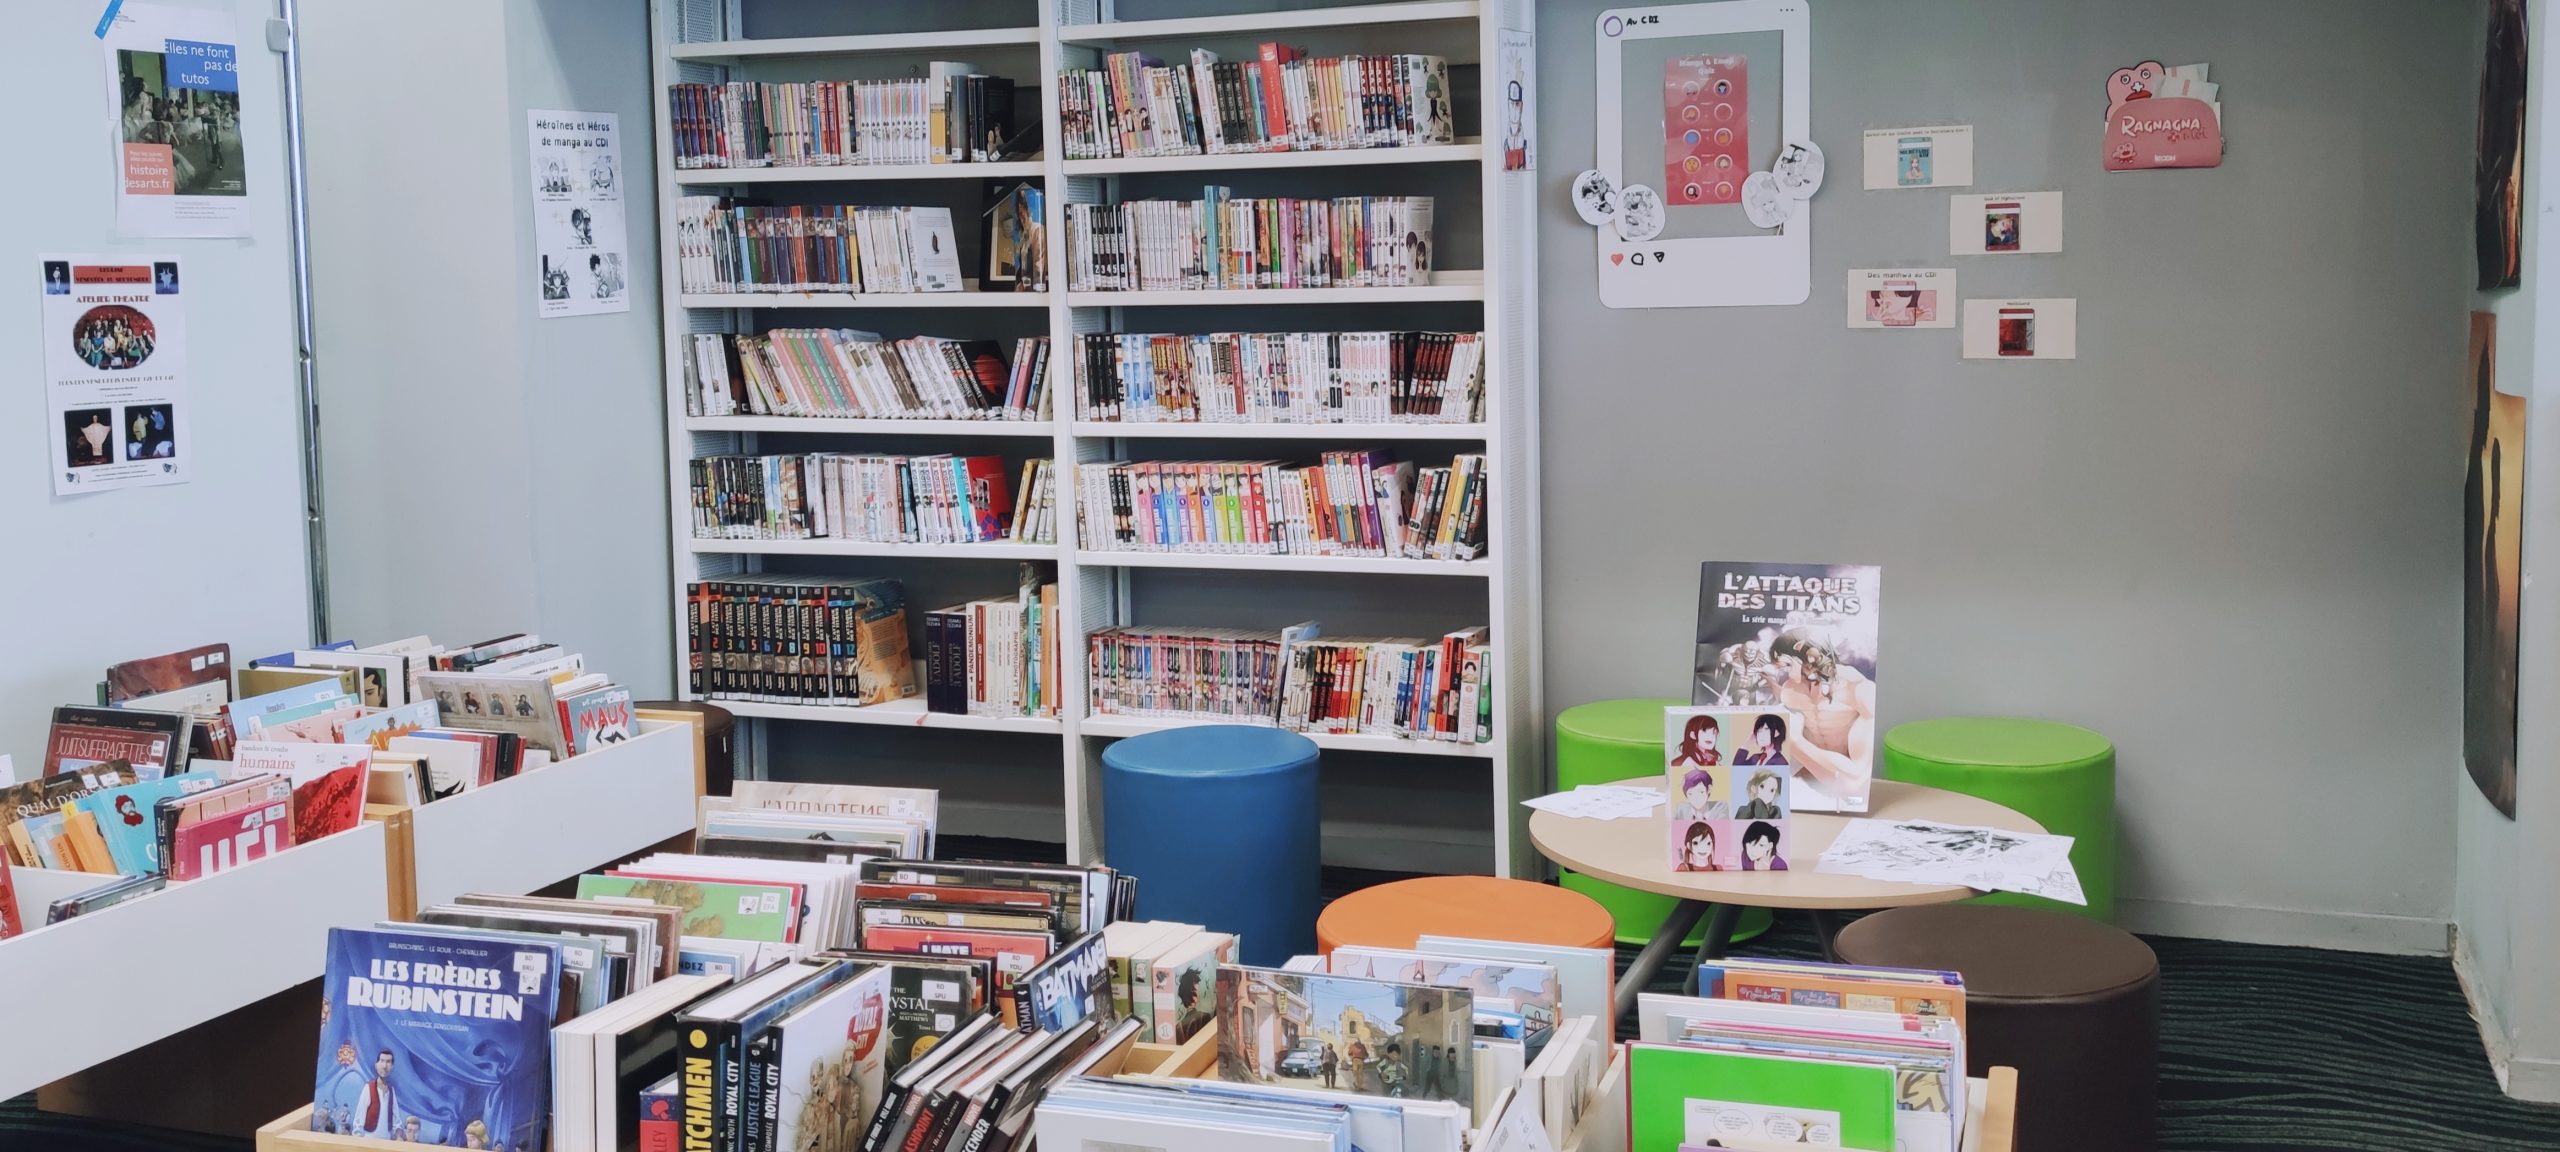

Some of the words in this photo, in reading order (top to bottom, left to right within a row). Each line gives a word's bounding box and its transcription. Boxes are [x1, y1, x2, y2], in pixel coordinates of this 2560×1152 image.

[1626, 17, 1638, 27] Au
[164, 41, 188, 55] Elles
[191, 46, 204, 56] ne
[206, 45, 230, 59] font
[204, 60, 222, 72] pas
[224, 61, 237, 72] de
[181, 72, 210, 85] tutos
[536, 119, 574, 131] Héroïnes
[577, 121, 585, 131] et
[587, 120, 610, 132] Héros
[541, 137, 551, 146] de
[554, 138, 581, 149] manga
[584, 139, 593, 147] au
[130, 164, 168, 176] histoire
[125, 177, 171, 190] desarts.fr
[1723, 571, 1857, 596] L'ATTAQUE
[1718, 592, 1766, 610] DES
[1772, 593, 1861, 614] TITANS
[692, 639, 697, 649] 1
[712, 637, 719, 649] 2
[727, 639, 733, 650] 3
[739, 640, 745, 651] 4
[751, 639, 757, 650] 5
[764, 640, 771, 652] 6
[777, 641, 783, 653] 7
[789, 642, 795, 653] 8
[803, 643, 810, 654] 9
[815, 643, 826, 654] 10
[833, 644, 841, 655] 11
[846, 644, 855, 655] 12
[579, 700, 629, 736] MAUS
[239, 753, 296, 770] humains
[17, 797, 51, 817] QUAI
[370, 958, 409, 983] LES
[413, 960, 501, 990] FRÈRES
[1038, 938, 1107, 1010] BATMAN
[347, 976, 523, 1022] RUBINSTEIN
[890, 996, 935, 1014] YSTAL
[1019, 1001, 1033, 1035] ATMAN
[726, 1060, 739, 1083] CITY
[766, 1063, 779, 1086] CITY
[749, 1062, 761, 1099] LEAGUE
[685, 1057, 712, 1152] TCHMEN
[726, 1085, 739, 1116] ROYAL
[764, 1092, 777, 1120] ROYAL
[747, 1100, 760, 1139] JUSTICE
[727, 1119, 736, 1140] YOUTH
[764, 1123, 774, 1152] COMPOSÉE
